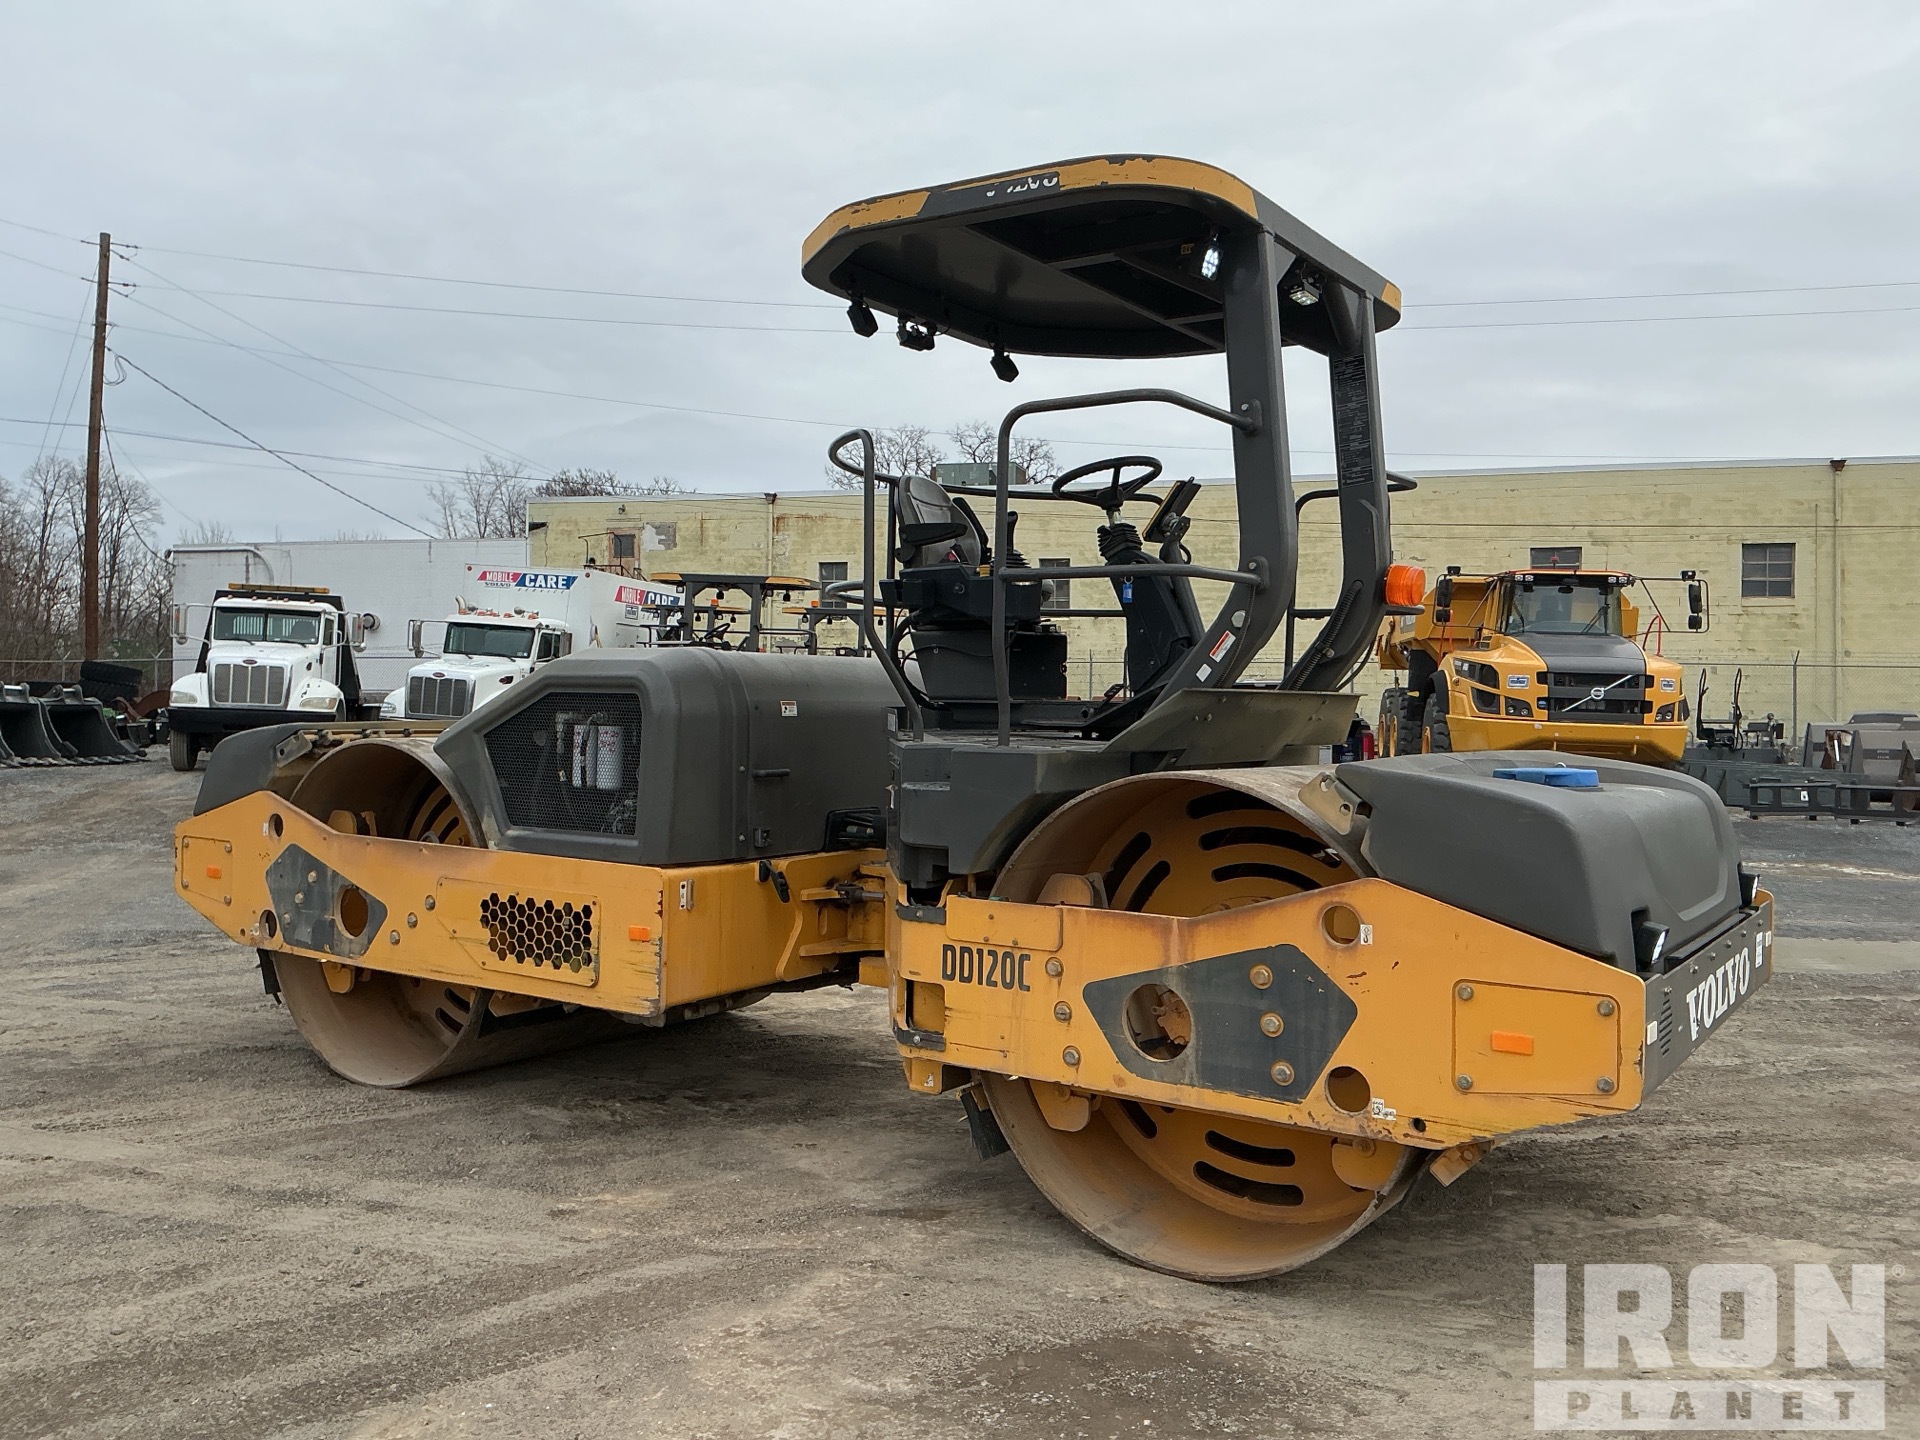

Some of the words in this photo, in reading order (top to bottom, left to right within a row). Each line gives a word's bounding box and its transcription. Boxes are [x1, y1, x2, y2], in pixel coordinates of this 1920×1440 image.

[486, 571, 513, 583] MOBILE
[525, 573, 567, 589] CARE
[621, 586, 641, 604] MOBILE
[942, 944, 1031, 992] DD120C
[1686, 947, 1750, 1041] VOLVO
